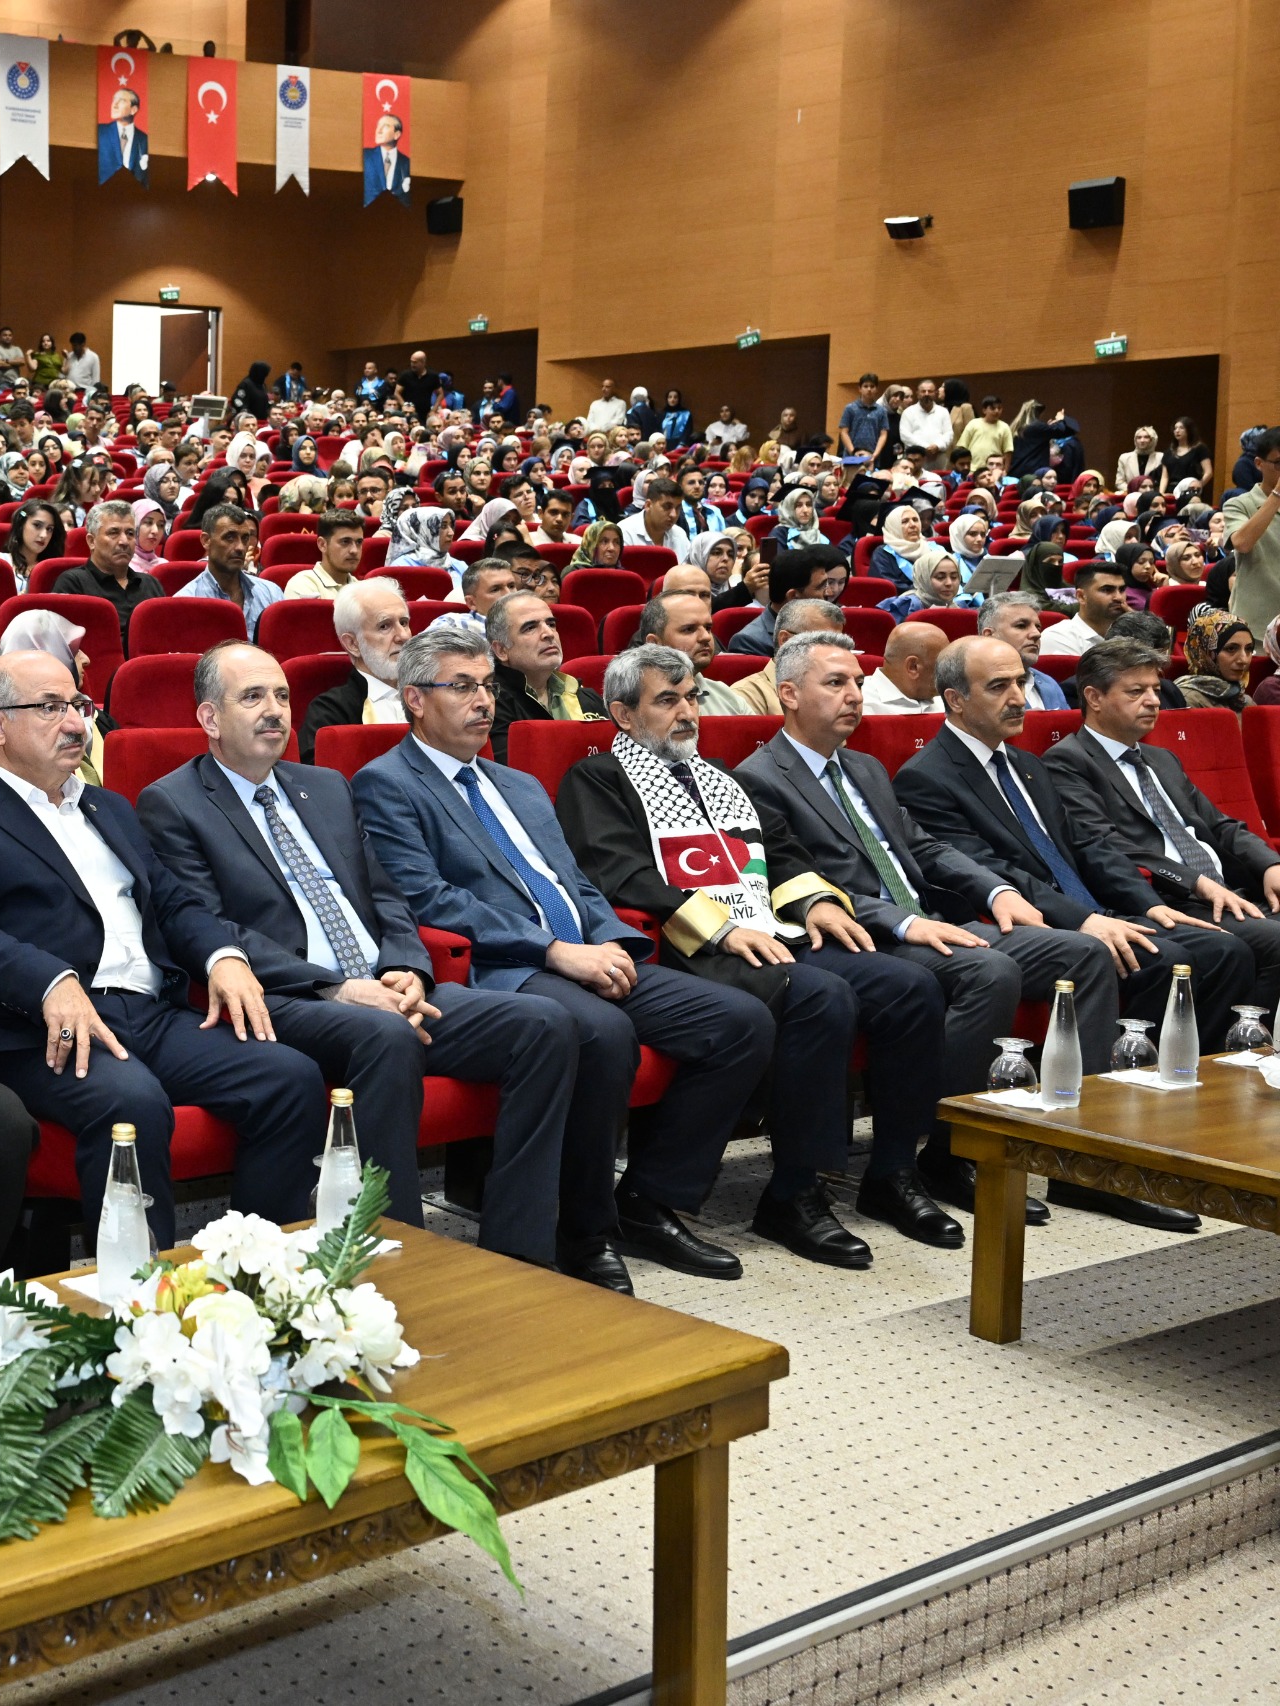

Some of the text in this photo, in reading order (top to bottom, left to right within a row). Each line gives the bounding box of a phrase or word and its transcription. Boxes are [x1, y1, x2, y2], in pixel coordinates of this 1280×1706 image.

[1051, 731, 1061, 741] 23
[1177, 730, 1187, 741] 24
[914, 738, 925, 749] 22
[587, 745, 599, 757] 20
[709, 892, 746, 906] İMİZ
